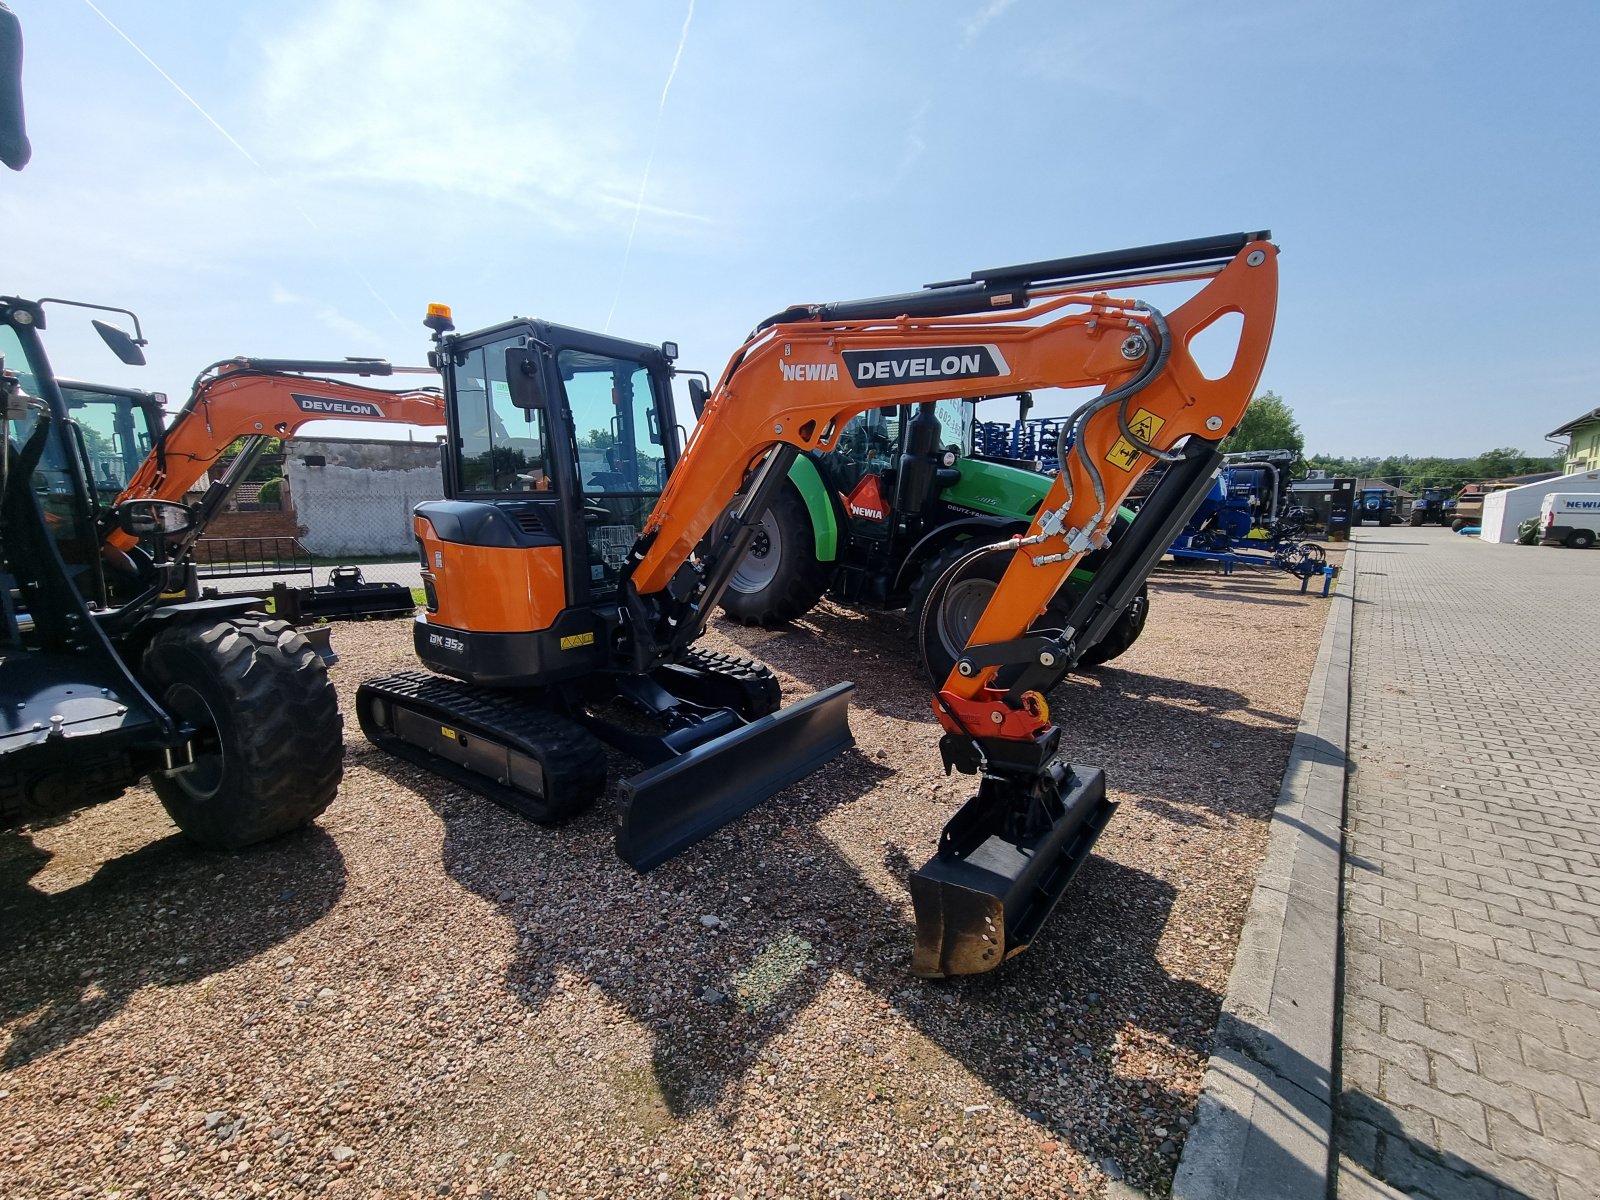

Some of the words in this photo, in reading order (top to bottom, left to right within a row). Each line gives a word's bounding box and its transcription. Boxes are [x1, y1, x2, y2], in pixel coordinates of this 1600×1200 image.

[782, 362, 839, 381] NEWIA
[857, 354, 981, 380] DEVELON
[302, 400, 371, 414] DEVELON
[852, 506, 882, 520] NEWIA
